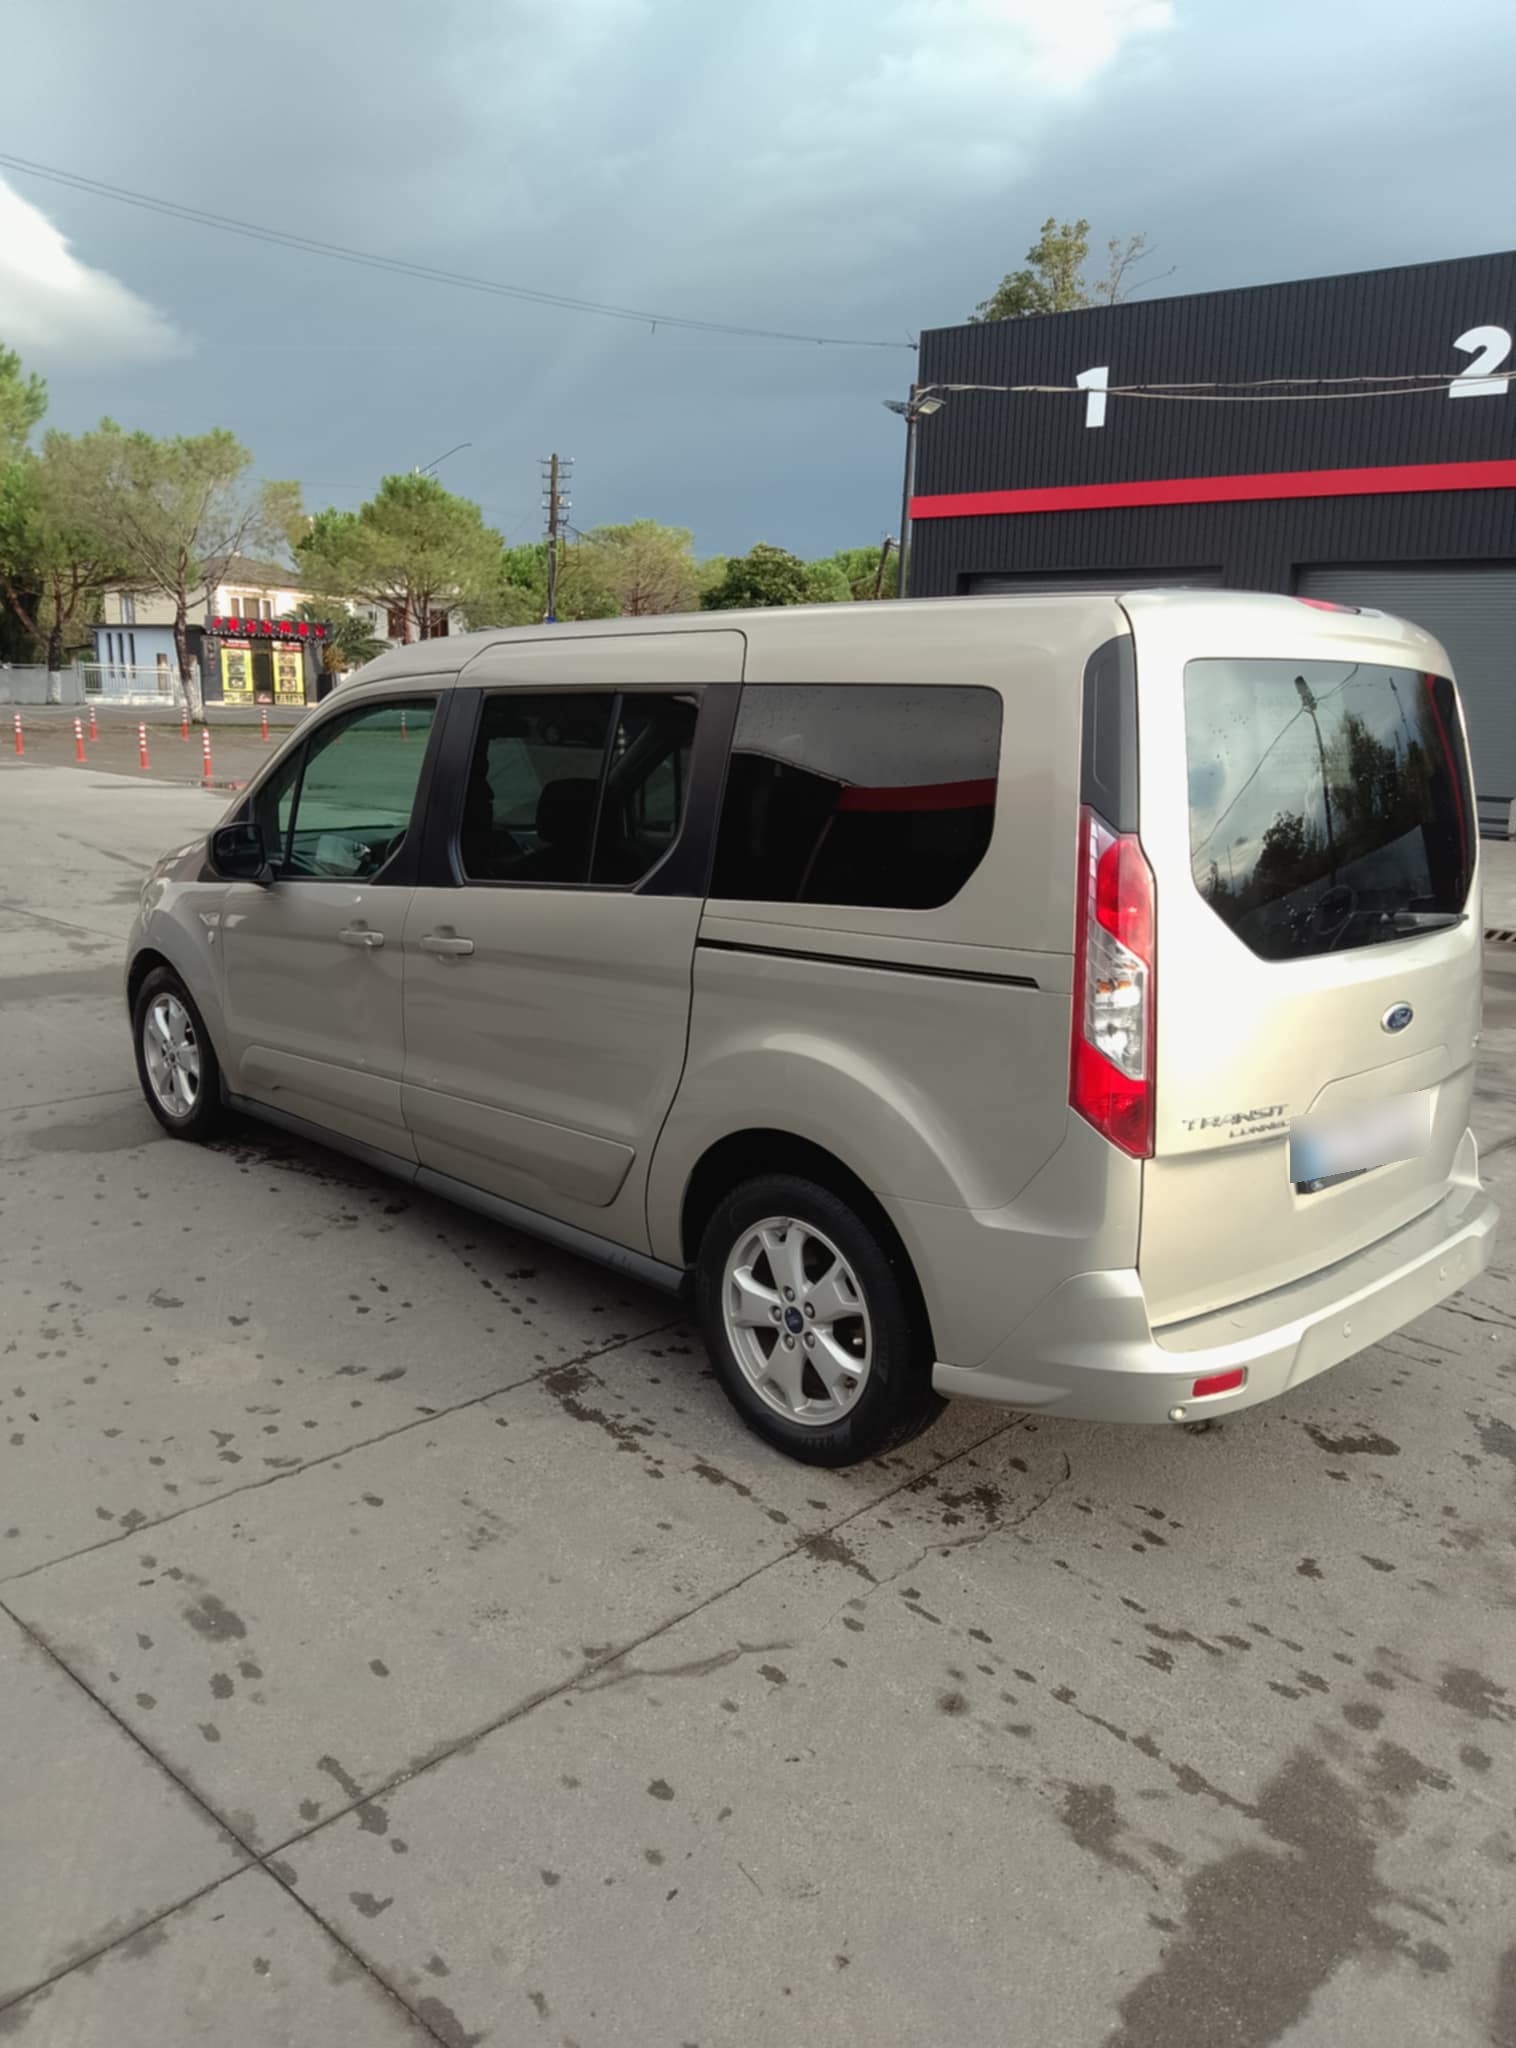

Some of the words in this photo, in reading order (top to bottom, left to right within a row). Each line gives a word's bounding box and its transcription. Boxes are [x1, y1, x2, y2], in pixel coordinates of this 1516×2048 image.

[1449, 325, 1513, 399] 2
[1076, 366, 1109, 428] 1
[1182, 1103, 1289, 1132] TRANSIT
[1228, 1120, 1290, 1138] CONNEC
